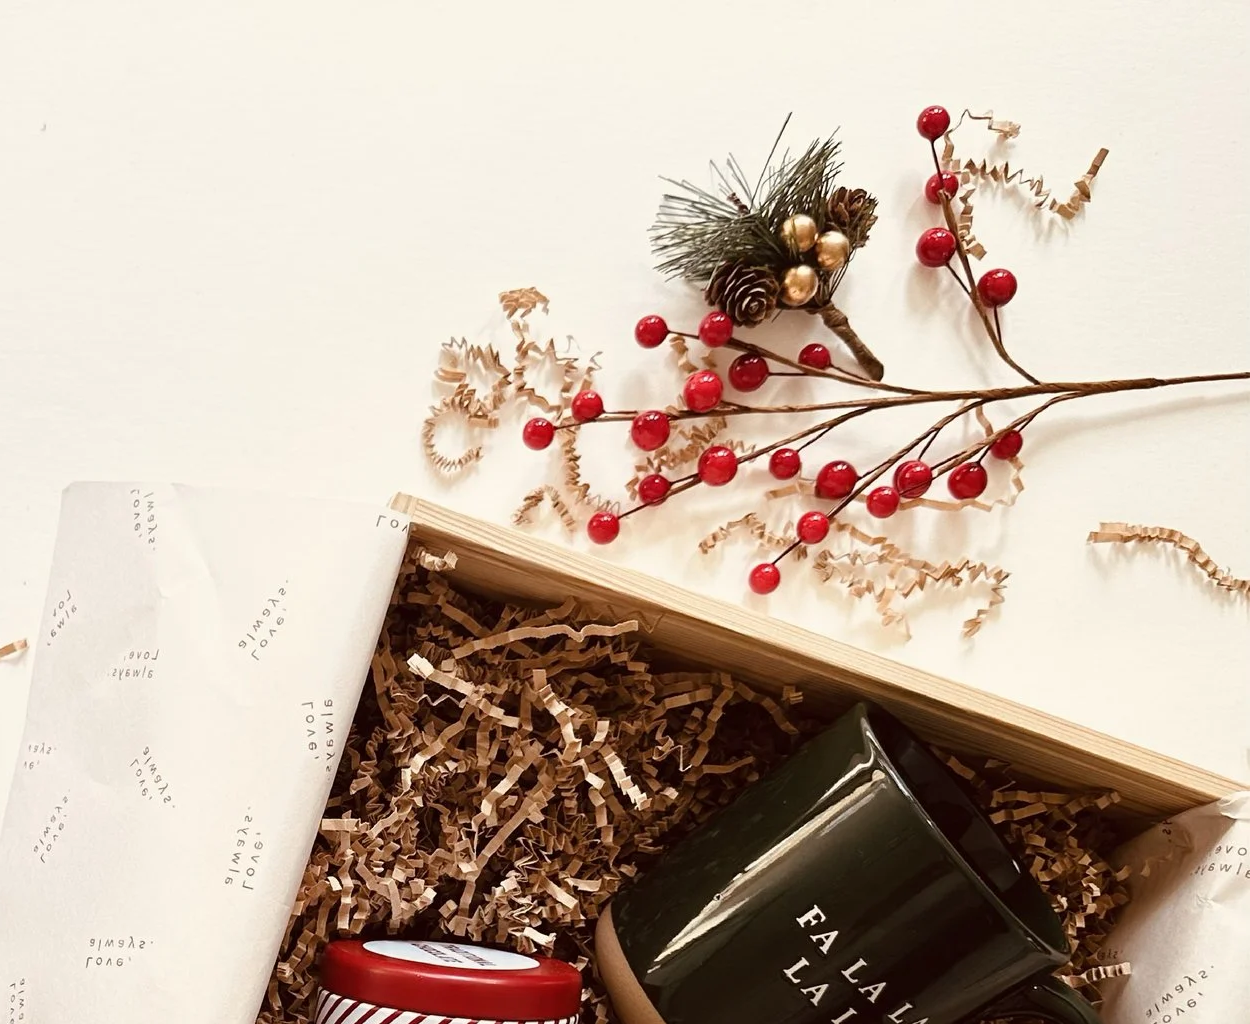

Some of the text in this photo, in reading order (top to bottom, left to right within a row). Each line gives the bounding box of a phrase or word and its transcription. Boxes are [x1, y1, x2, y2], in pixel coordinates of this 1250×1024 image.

[783, 956, 829, 1007] LA
[796, 904, 839, 954] FA
[841, 957, 887, 1004] LA
